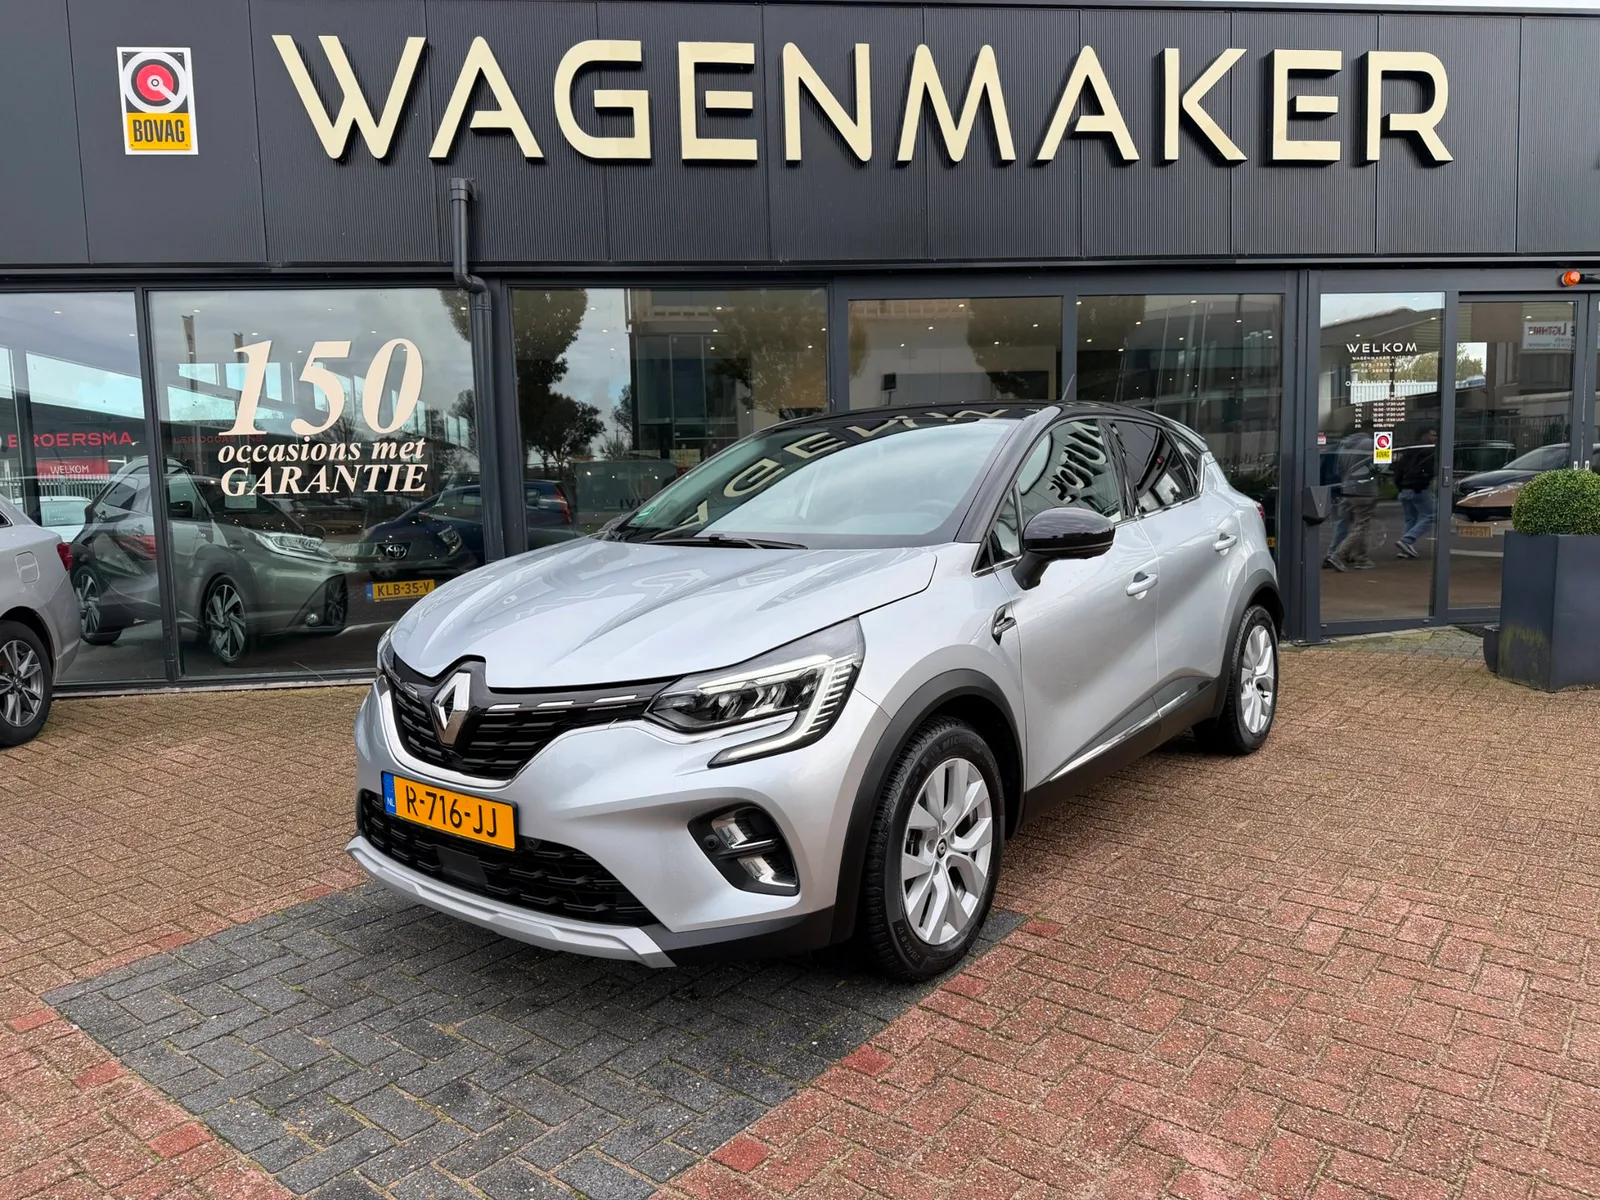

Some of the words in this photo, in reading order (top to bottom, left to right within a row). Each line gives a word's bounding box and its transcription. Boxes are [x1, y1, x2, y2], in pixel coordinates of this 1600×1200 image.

[272, 35, 1454, 162] WAGENMAKER
[132, 119, 186, 142] BOVAG
[1346, 342, 1417, 353] WELKOM
[218, 338, 424, 436] 150
[217, 436, 362, 463] occasions
[371, 438, 426, 460] met
[50, 464, 90, 474] WELKOM
[220, 464, 429, 497] GARANTIE
[377, 581, 430, 597] KLB-35-V
[405, 785, 498, 838] R-716-JJ
